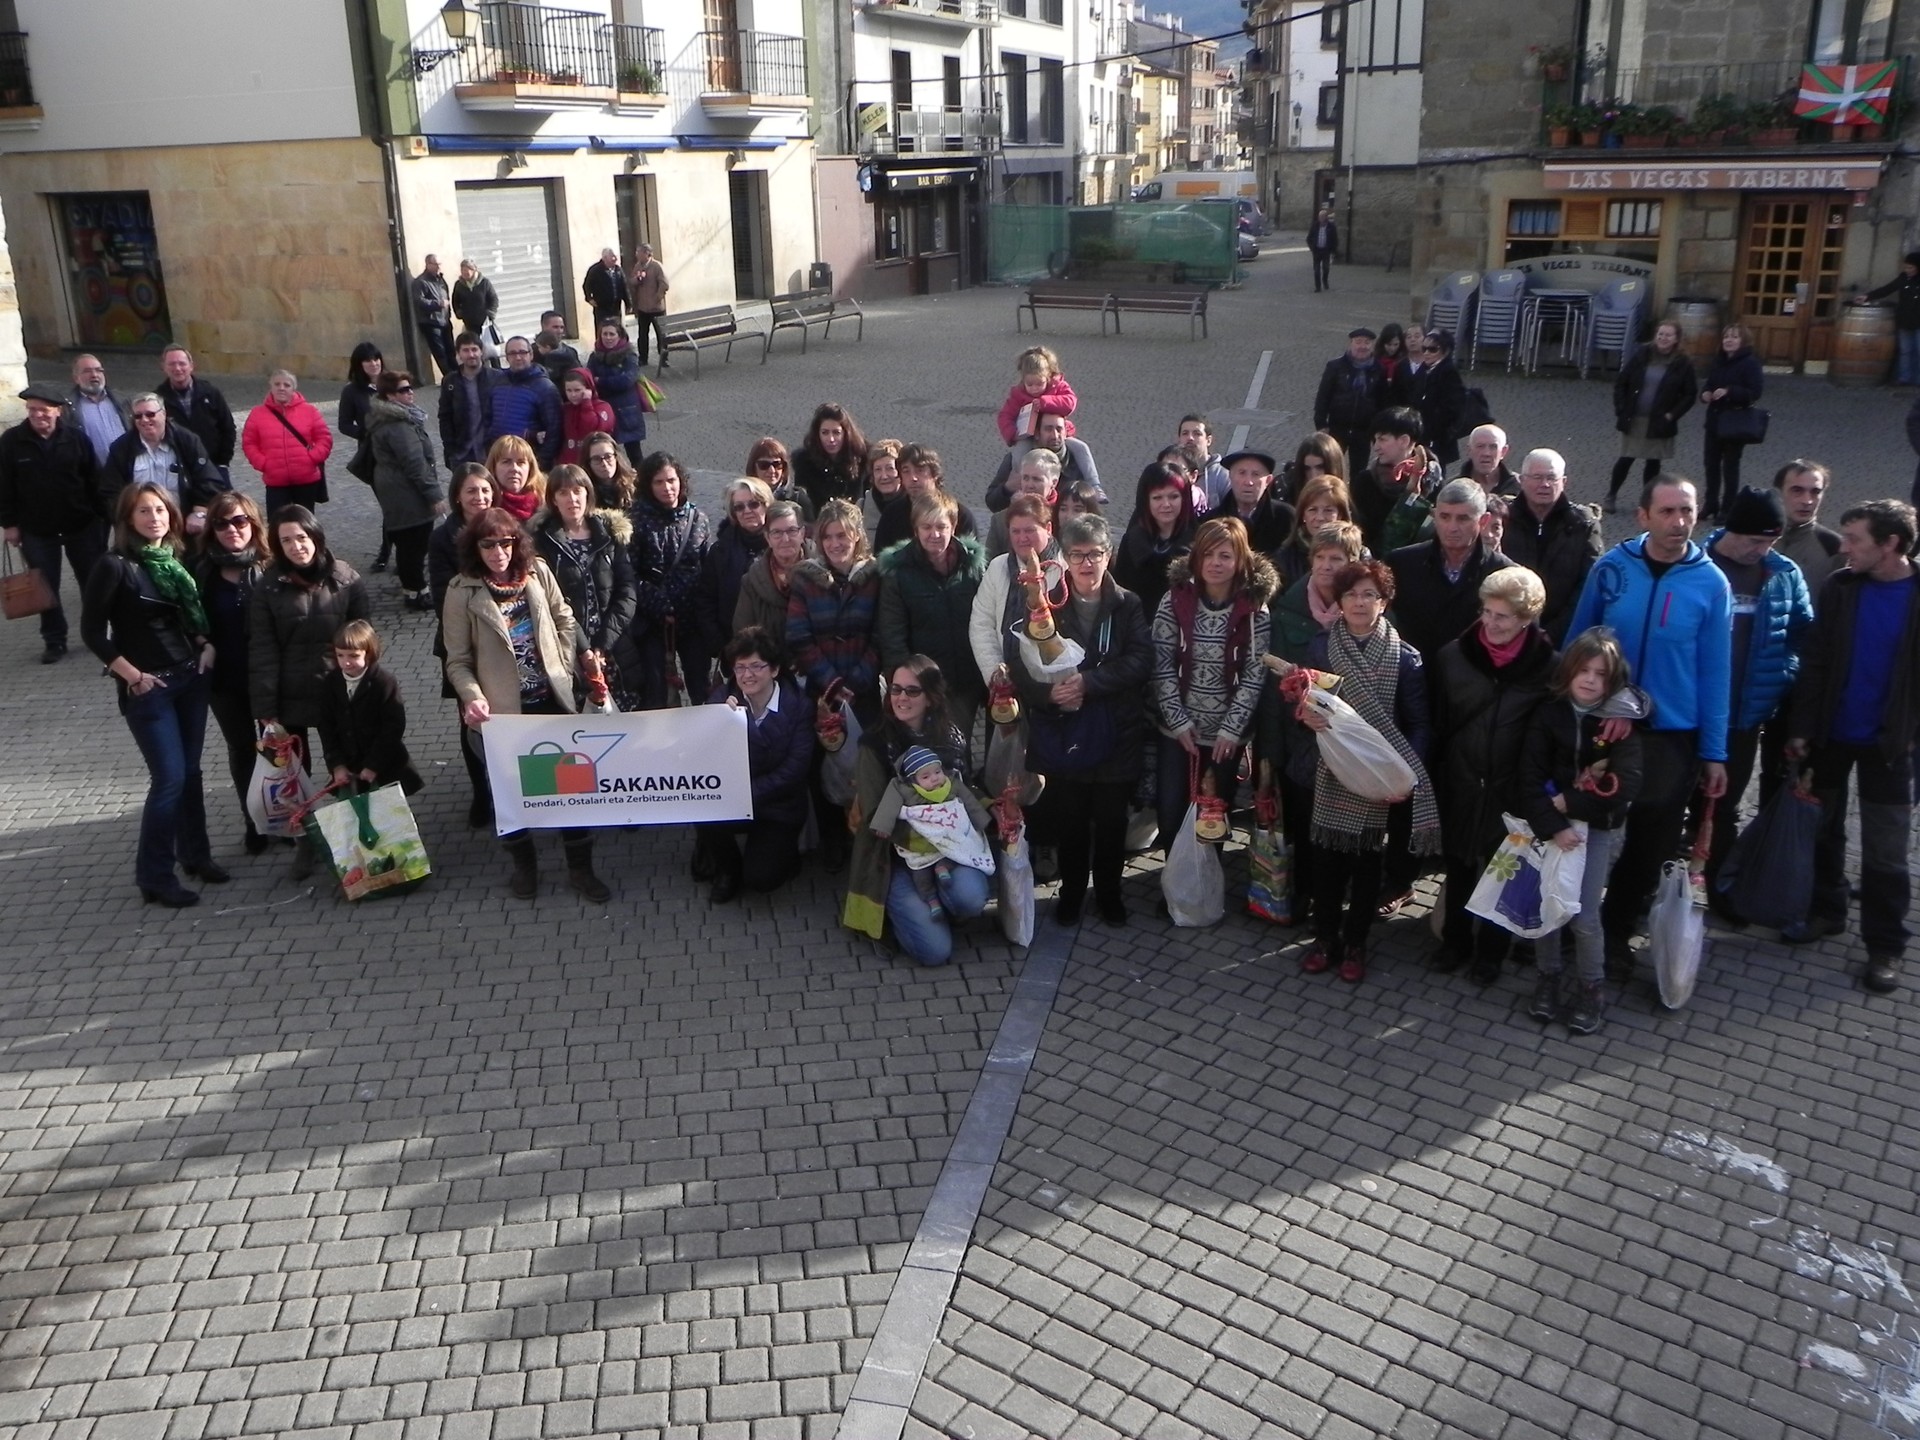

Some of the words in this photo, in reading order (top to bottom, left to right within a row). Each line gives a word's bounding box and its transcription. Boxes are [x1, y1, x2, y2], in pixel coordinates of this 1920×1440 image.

[862, 106, 885, 125] KELER
[918, 175, 930, 186] BAR
[1568, 171, 1612, 189] LAS
[1629, 170, 1709, 189] VEGAS
[1726, 168, 1848, 189] TABERNA
[1542, 261, 1581, 271] VEGAS
[599, 774, 722, 794] SAKANAKO
[523, 798, 566, 809] Dendari,
[567, 796, 606, 806] Ostalari
[608, 795, 624, 804] eta
[626, 794, 680, 803] Zerbitzuen
[682, 793, 722, 801] Elkartea
